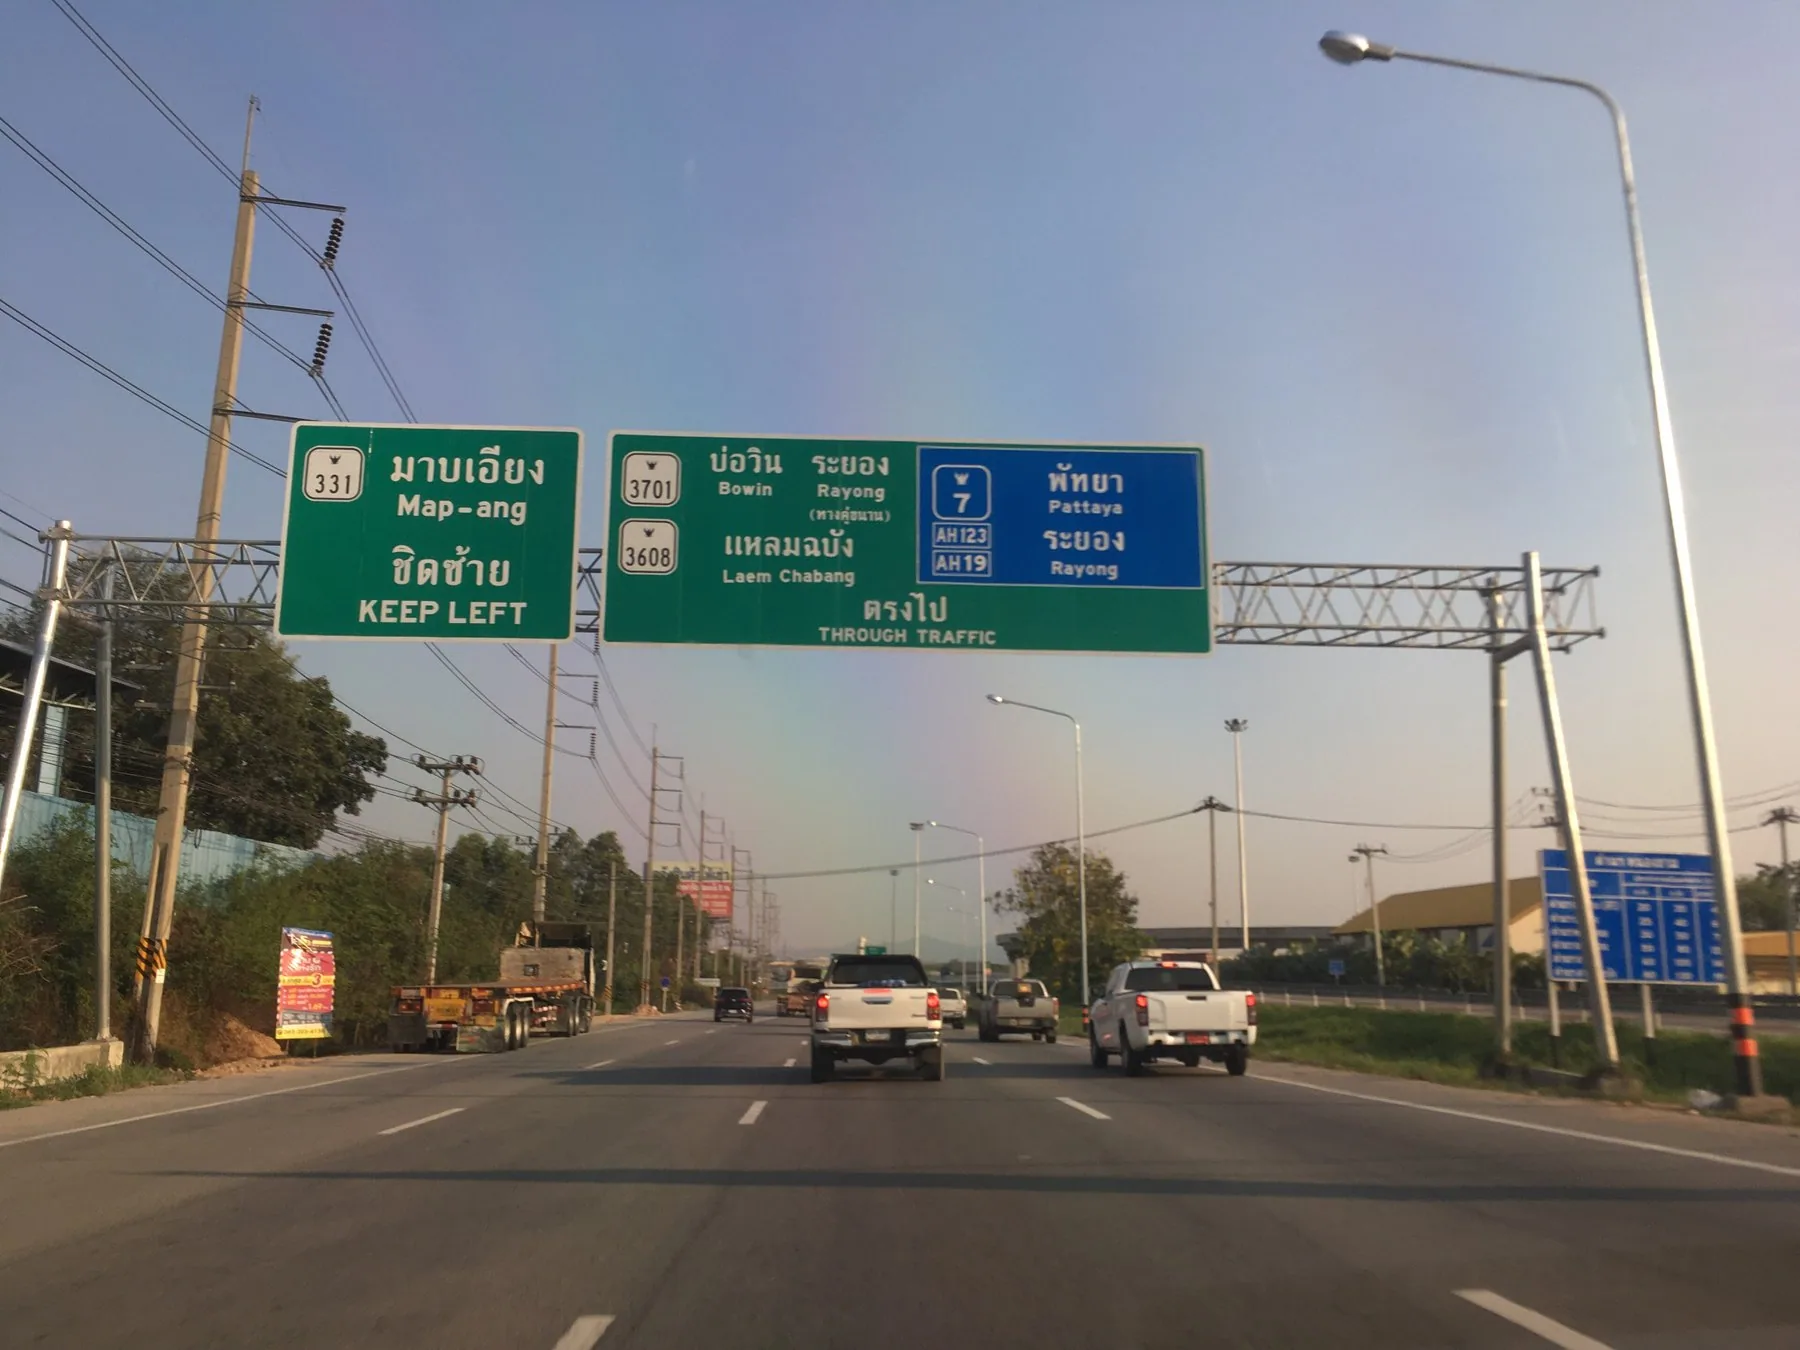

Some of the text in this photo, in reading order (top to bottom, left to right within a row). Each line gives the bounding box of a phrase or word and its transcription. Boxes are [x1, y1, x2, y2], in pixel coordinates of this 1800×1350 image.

[390, 445, 545, 485] มาบเอียง
[709, 446, 783, 474] บ่อวิน
[812, 454, 890, 477] ระยอง
[315, 474, 351, 494] 331
[1048, 462, 1124, 493] พัทยา
[629, 479, 672, 500] 3701
[718, 481, 773, 497] Bowin
[817, 484, 886, 502] Rayong
[397, 494, 528, 526] Map-ang
[952, 493, 971, 514] 7
[1048, 500, 1123, 517] Pattaya
[724, 529, 854, 558] แหลมฉบัง
[1043, 529, 1125, 552] ระยอง
[391, 544, 511, 587] ชิดซ้าย
[625, 546, 671, 568] 3608
[722, 569, 855, 587] Laem Chabang
[1050, 561, 1119, 581] Rayong
[358, 599, 528, 625] KEEP LEFT
[864, 592, 948, 623] ตรงไป
[818, 626, 997, 645] THROUGH TRAFFIC
